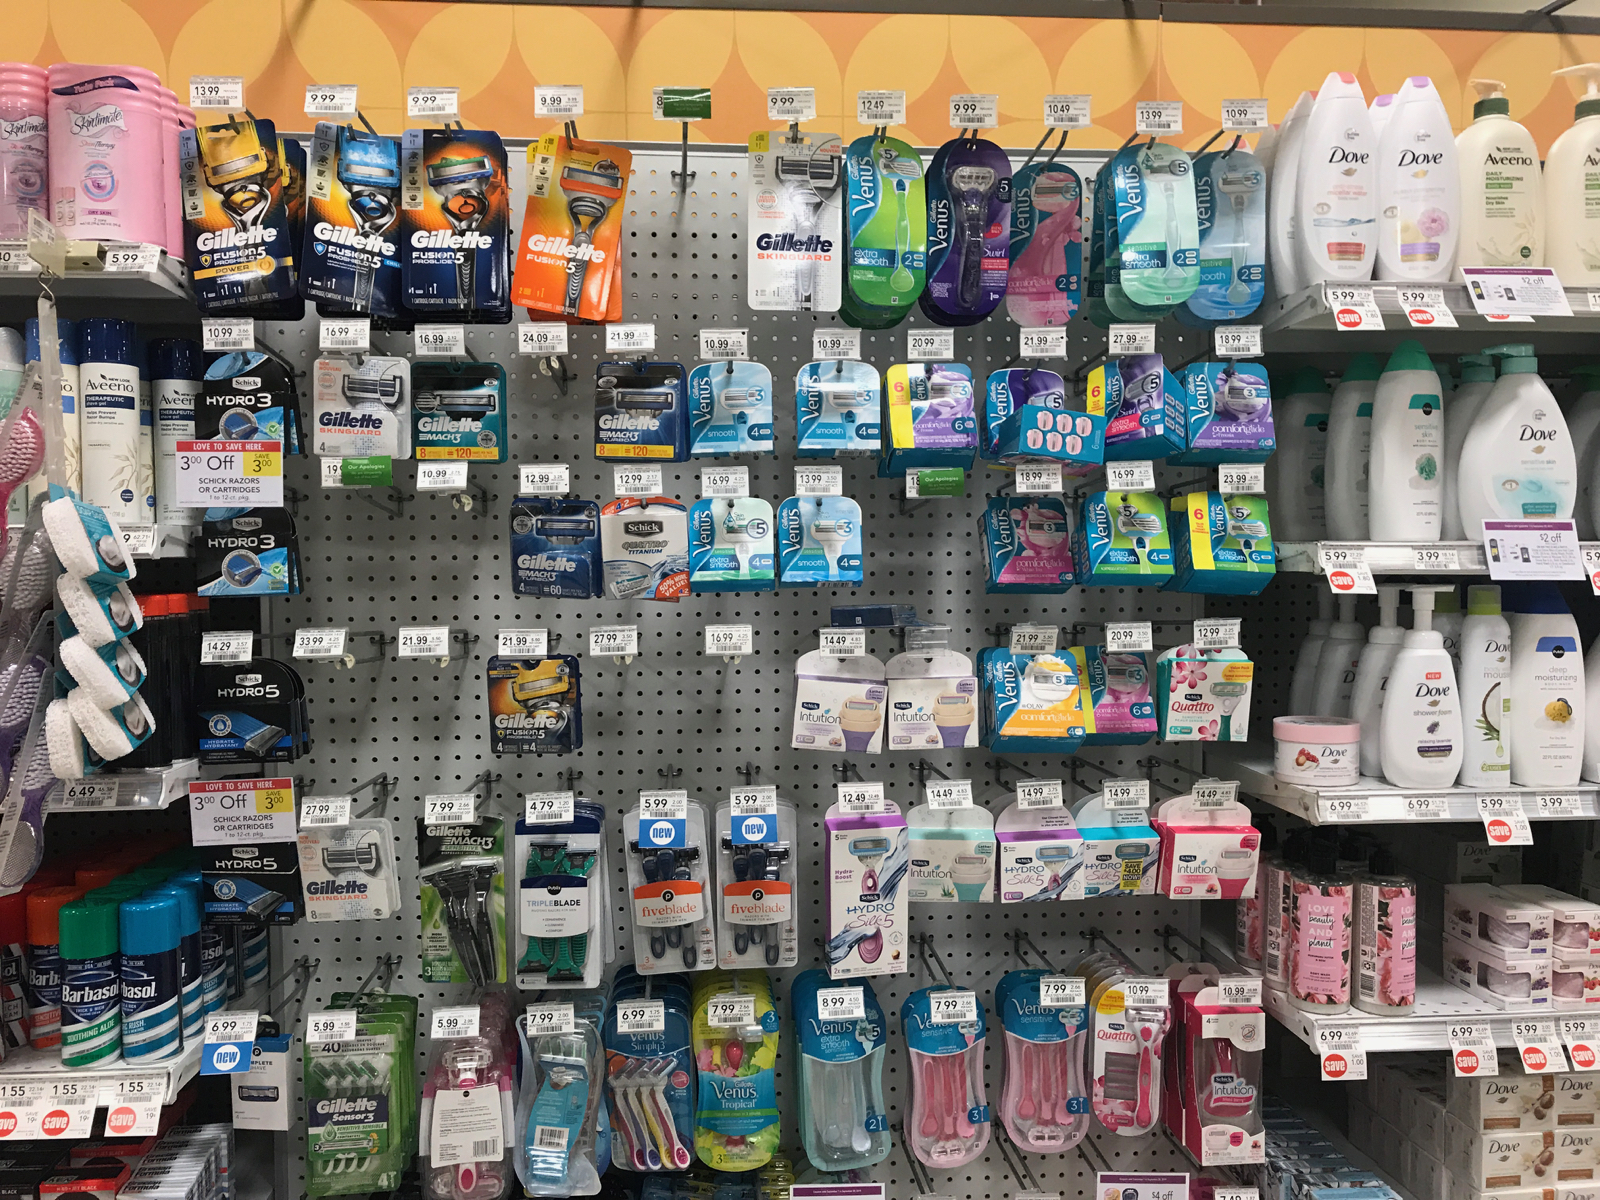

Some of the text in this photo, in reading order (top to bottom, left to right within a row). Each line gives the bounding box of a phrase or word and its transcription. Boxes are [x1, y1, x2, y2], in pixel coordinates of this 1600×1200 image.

[540, 96, 562, 106] 9.99
[74, 110, 122, 133] Skintimate
[1328, 146, 1369, 164] Dove
[1398, 150, 1443, 167] Dove
[1484, 152, 1531, 166] Aveeno
[196, 228, 278, 252] Gillette
[313, 223, 397, 257] Gillette
[411, 231, 493, 250] Gillette
[756, 233, 834, 253] Gillette
[527, 234, 606, 263] Gillette
[854, 249, 878, 258] extra
[983, 246, 1006, 259] Swirl
[111, 254, 138, 263] 5.99
[757, 252, 832, 261] SKINGUARD
[215, 264, 250, 274] POWER
[1533, 277, 1544, 285] off
[1338, 312, 1360, 323] save
[1410, 311, 1433, 322] save
[208, 328, 233, 338] 10.99
[523, 333, 548, 342] 24.09
[610, 330, 635, 340] 21.99
[418, 334, 444, 344] 16.99
[705, 339, 728, 349] 10.99
[817, 338, 841, 348] 10.99
[1024, 336, 1048, 345] 21.99
[1114, 334, 1137, 344] 27.99
[86, 380, 132, 393] Aveeno
[235, 379, 260, 387] Schick
[206, 395, 256, 406] HYDRO
[693, 376, 711, 428] Venus
[1191, 374, 1208, 427] Venus
[318, 411, 383, 429] Gillette
[418, 417, 483, 432] Gillette
[319, 428, 382, 436] SKINGUARD
[816, 427, 843, 435] smooth
[1414, 423, 1438, 431] sensitive
[708, 428, 736, 437] smooth
[1422, 430, 1433, 438] skin
[1519, 424, 1557, 442] Dove
[207, 455, 235, 470] Off
[422, 469, 447, 478] 10.99
[525, 473, 550, 482] 12.99
[1224, 474, 1247, 484] 23.99
[235, 519, 260, 527] Schick
[208, 536, 258, 548] HYDRO
[1417, 552, 1439, 560] 3.99
[517, 554, 577, 572] Gillette
[798, 559, 825, 567] smooth
[402, 635, 428, 645] 21.99
[502, 636, 527, 646] 21.99
[207, 641, 232, 652] 14.29
[1548, 666, 1568, 674] deep
[1535, 674, 1578, 682] moisturizing
[218, 687, 264, 697] HYDRO
[1416, 683, 1450, 697] Dove
[1171, 702, 1214, 714] Quattro
[495, 714, 558, 729] Gillette
[799, 711, 842, 724] Intuition
[1321, 746, 1348, 757] Dove
[68, 786, 95, 797] 6.49
[645, 798, 668, 808] 5.99
[735, 795, 757, 805] 5.99
[1408, 800, 1429, 808] 6.99
[1481, 799, 1503, 808] 5.99
[430, 802, 454, 812] 7.99
[530, 801, 554, 811] 4.79
[1330, 801, 1352, 810] 6.99
[427, 827, 471, 836] Gillette
[652, 826, 672, 839] new
[744, 823, 764, 835] new
[1489, 825, 1510, 836] save
[216, 860, 262, 869] HYDRO
[1004, 865, 1045, 874] HYDRO
[1177, 864, 1218, 874] Intuition
[307, 881, 368, 895] Gillette
[308, 893, 368, 901] SKINGUARD
[527, 899, 581, 907] TRIPLEBLADE
[731, 903, 785, 913] fiveblade
[846, 902, 895, 913] HYDRO
[642, 903, 697, 916] fiveblade
[1308, 904, 1334, 913] LOVE
[1308, 915, 1334, 932] beauty
[1309, 928, 1332, 936] AND
[1308, 938, 1333, 955] planet
[62, 980, 119, 1003] Barbasol
[1044, 984, 1067, 994] 7.99
[822, 997, 845, 1007] 8.99
[935, 1000, 958, 1010] 7.99
[712, 1004, 735, 1014] 7.99
[530, 1013, 554, 1023] 7.99
[622, 1009, 645, 1020] 6.99
[437, 1018, 458, 1028] 5.99
[1020, 1016, 1053, 1024] sensitive
[66, 1019, 115, 1043] SOOTHING ALOE
[313, 1022, 335, 1031] 5.99
[809, 1018, 852, 1035] Venus
[1451, 1027, 1473, 1036] 6.99
[1097, 1030, 1136, 1042] Quattro
[1320, 1030, 1342, 1041] 6.99
[215, 1050, 238, 1063] new
[1524, 1052, 1545, 1064] save
[1324, 1060, 1346, 1071] save
[1352, 1058, 1364, 1066] 1.00
[1457, 1056, 1478, 1068] save
[52, 1084, 78, 1095] 1.55
[118, 1082, 144, 1093] 1.55
[710, 1081, 757, 1099] Venus
[1486, 1081, 1519, 1095] Dove
[1560, 1078, 1593, 1092] Dove
[316, 1098, 378, 1113] Gillette
[1561, 1134, 1593, 1148] Dove
[1488, 1140, 1520, 1154] Dove
